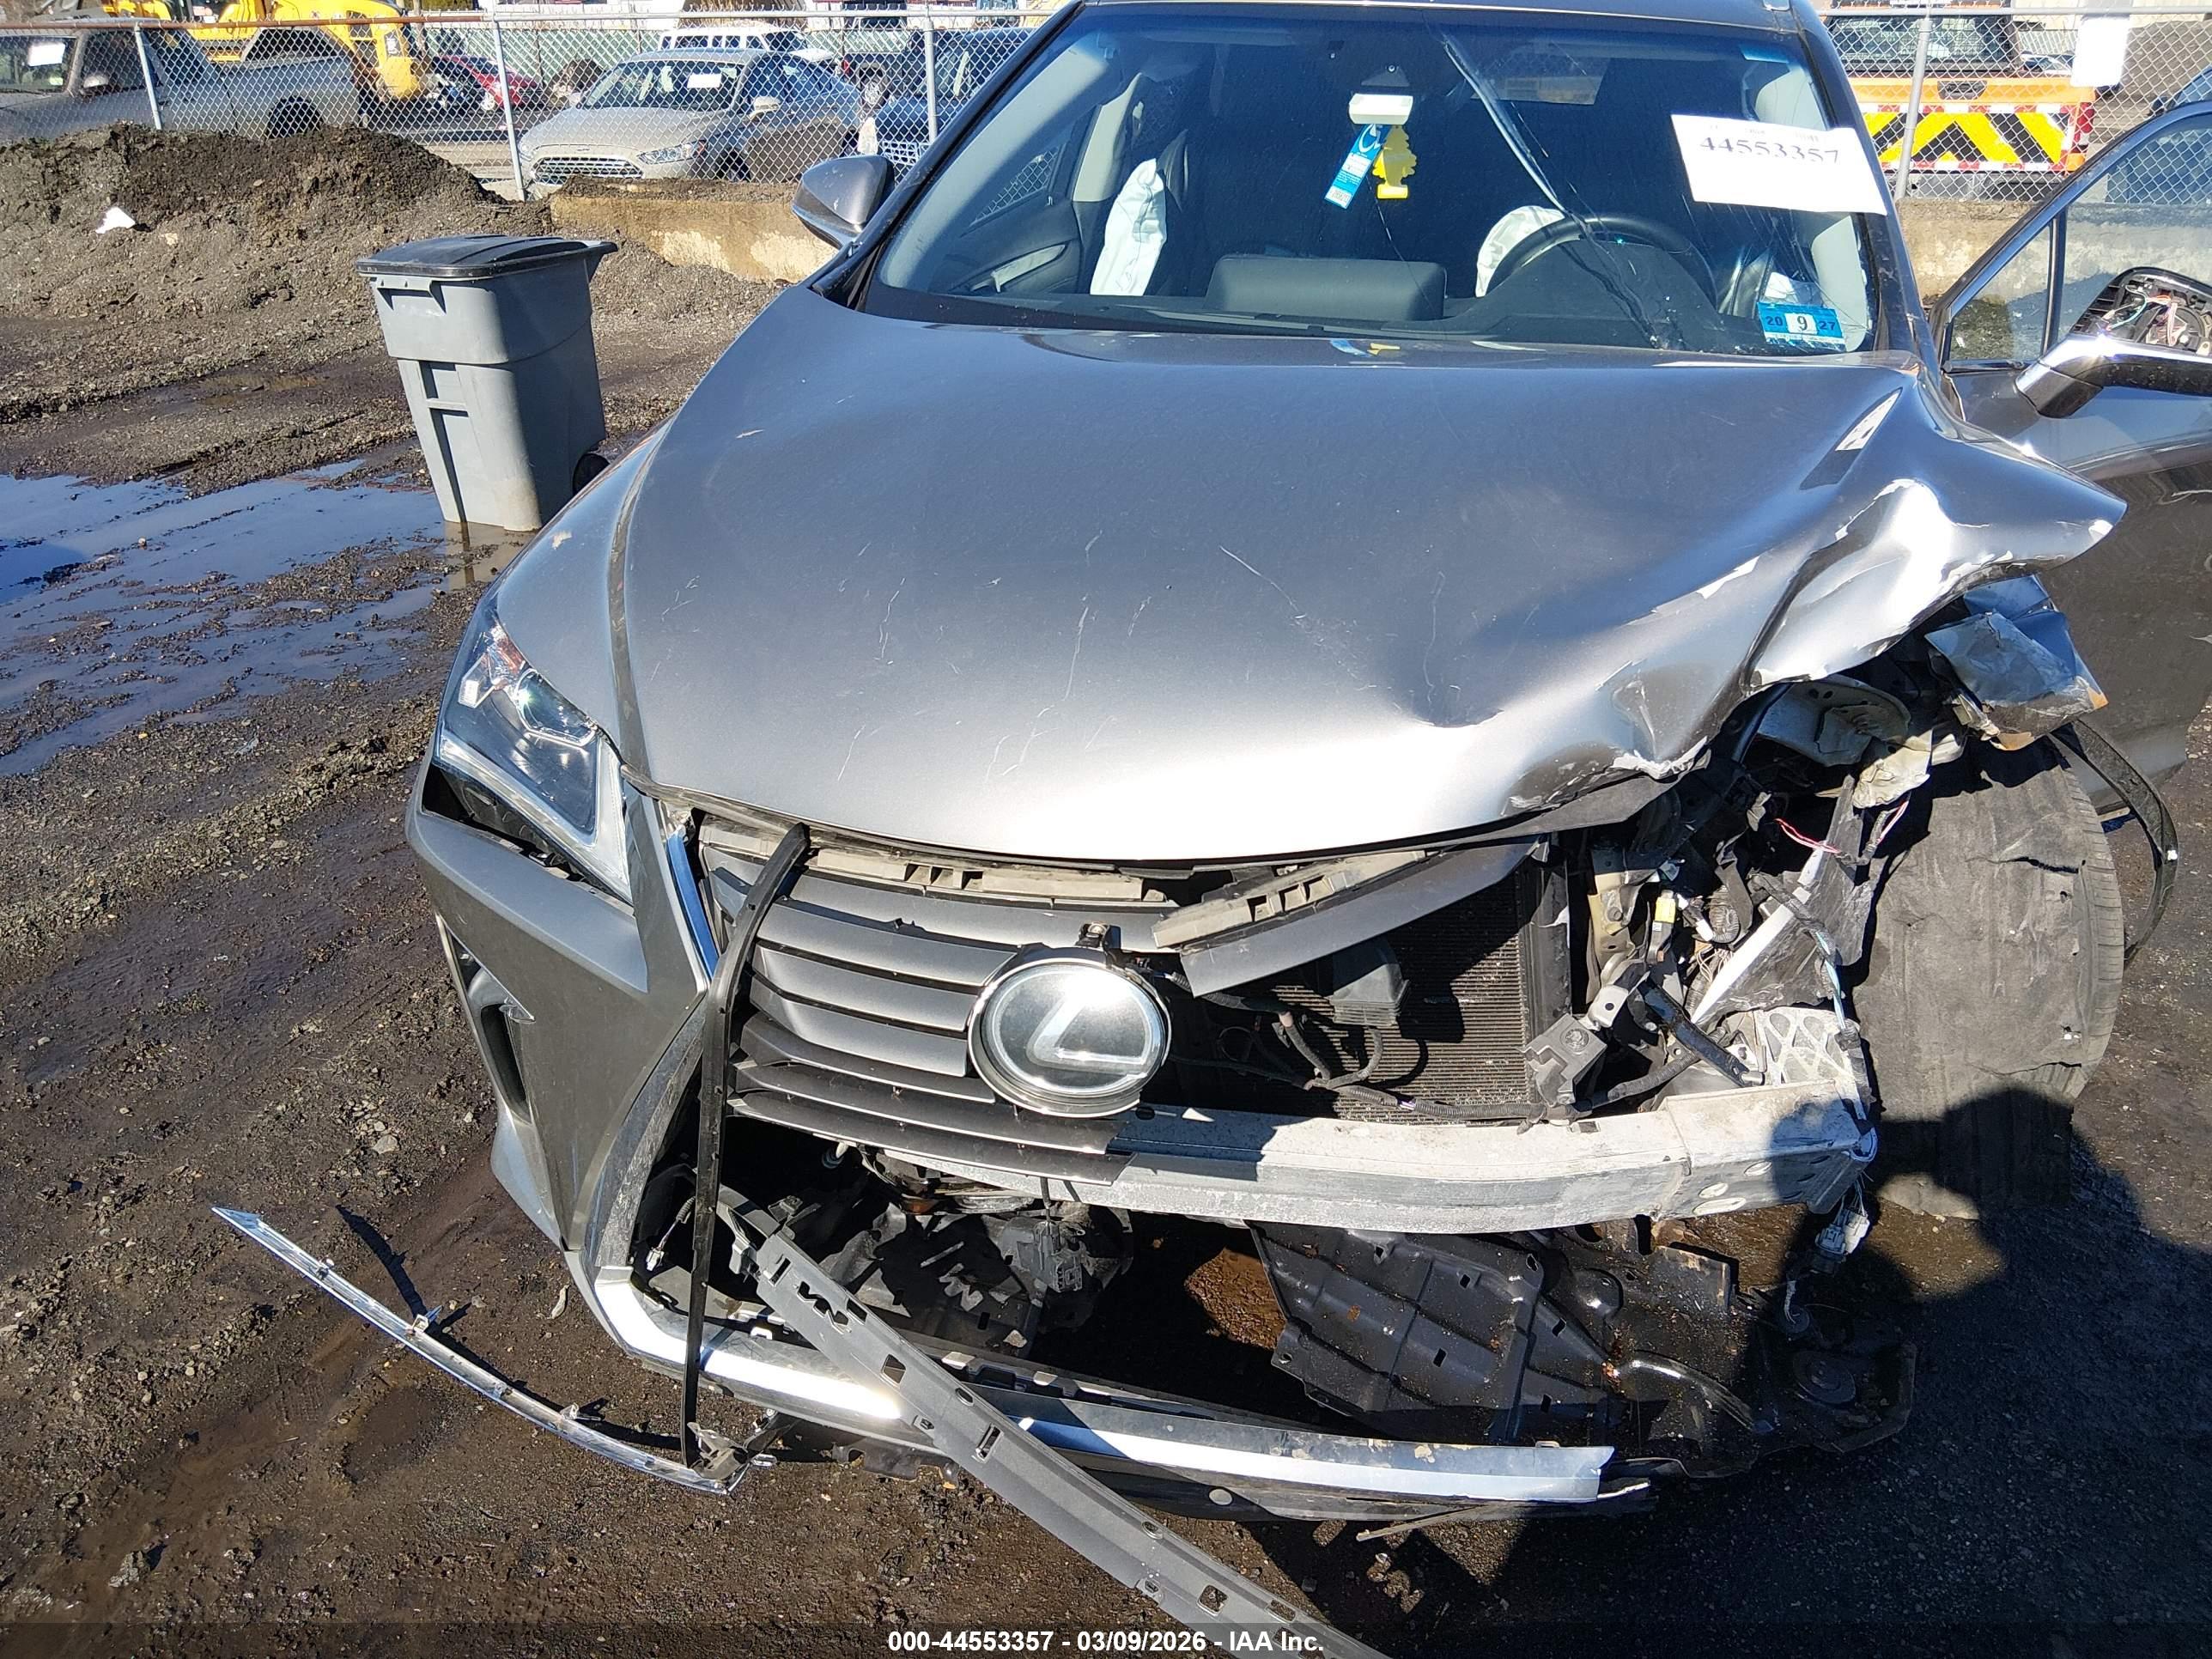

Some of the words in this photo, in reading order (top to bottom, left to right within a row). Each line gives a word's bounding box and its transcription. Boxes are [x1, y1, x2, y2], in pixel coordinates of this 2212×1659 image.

[1699, 137, 1838, 164] 44553357
[1765, 316, 1784, 326] 20
[1796, 315, 1808, 331] 9
[1819, 320, 1836, 331] 27
